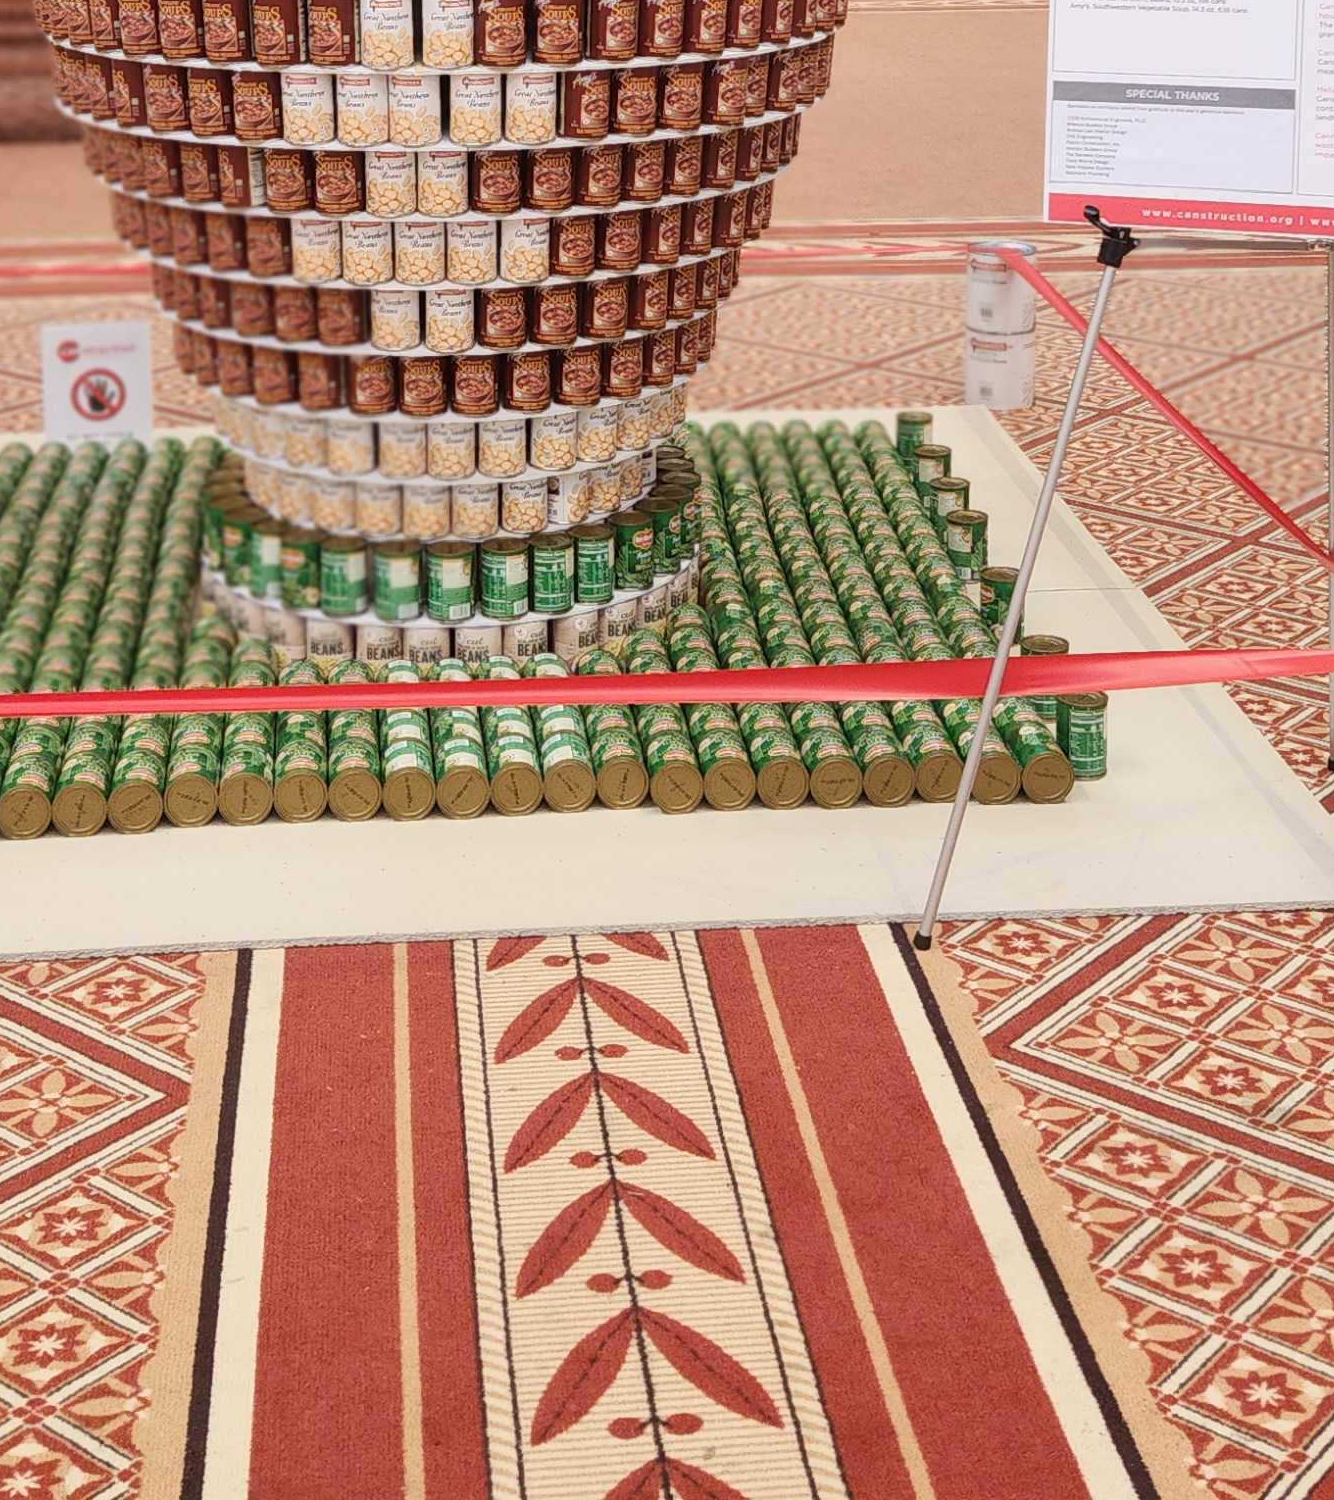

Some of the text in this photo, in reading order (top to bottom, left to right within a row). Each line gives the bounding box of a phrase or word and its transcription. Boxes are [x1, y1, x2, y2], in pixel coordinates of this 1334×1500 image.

[1125, 90, 1220, 101] SPECIAL THANKS
[1142, 208, 1293, 227] www.canstruction.org
